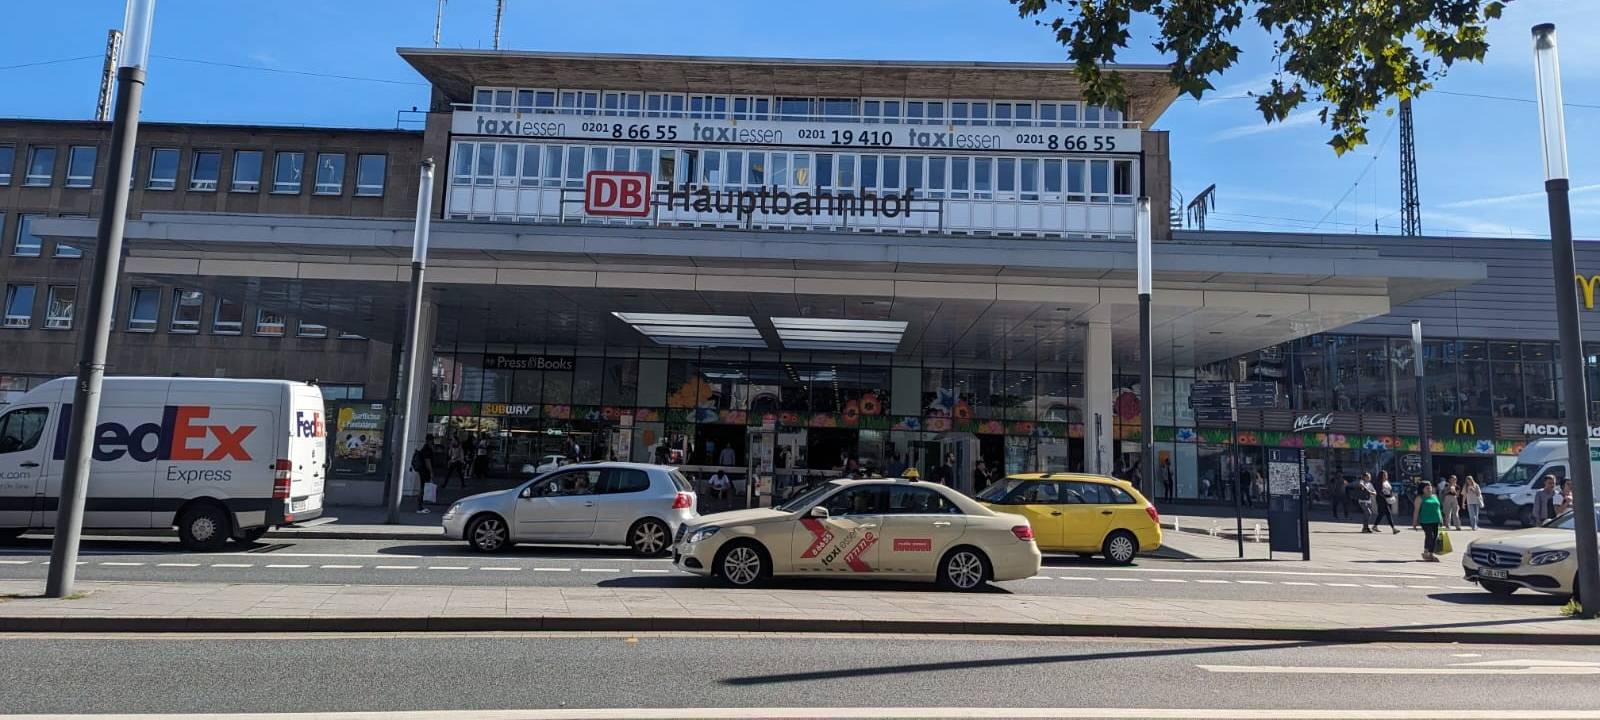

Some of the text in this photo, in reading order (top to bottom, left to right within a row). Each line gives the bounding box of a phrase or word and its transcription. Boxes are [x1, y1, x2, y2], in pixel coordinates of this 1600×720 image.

[582, 122, 609, 133] 0201
[798, 128, 825, 140] 0201
[831, 130, 853, 145] 19
[858, 130, 892, 146] 410
[1016, 132, 1044, 145] 0201
[593, 177, 914, 220] DB Hauptbahnhof
[486, 403, 533, 415] SUBWAY
[296, 411, 326, 438] FedEx
[167, 466, 232, 482] Express
